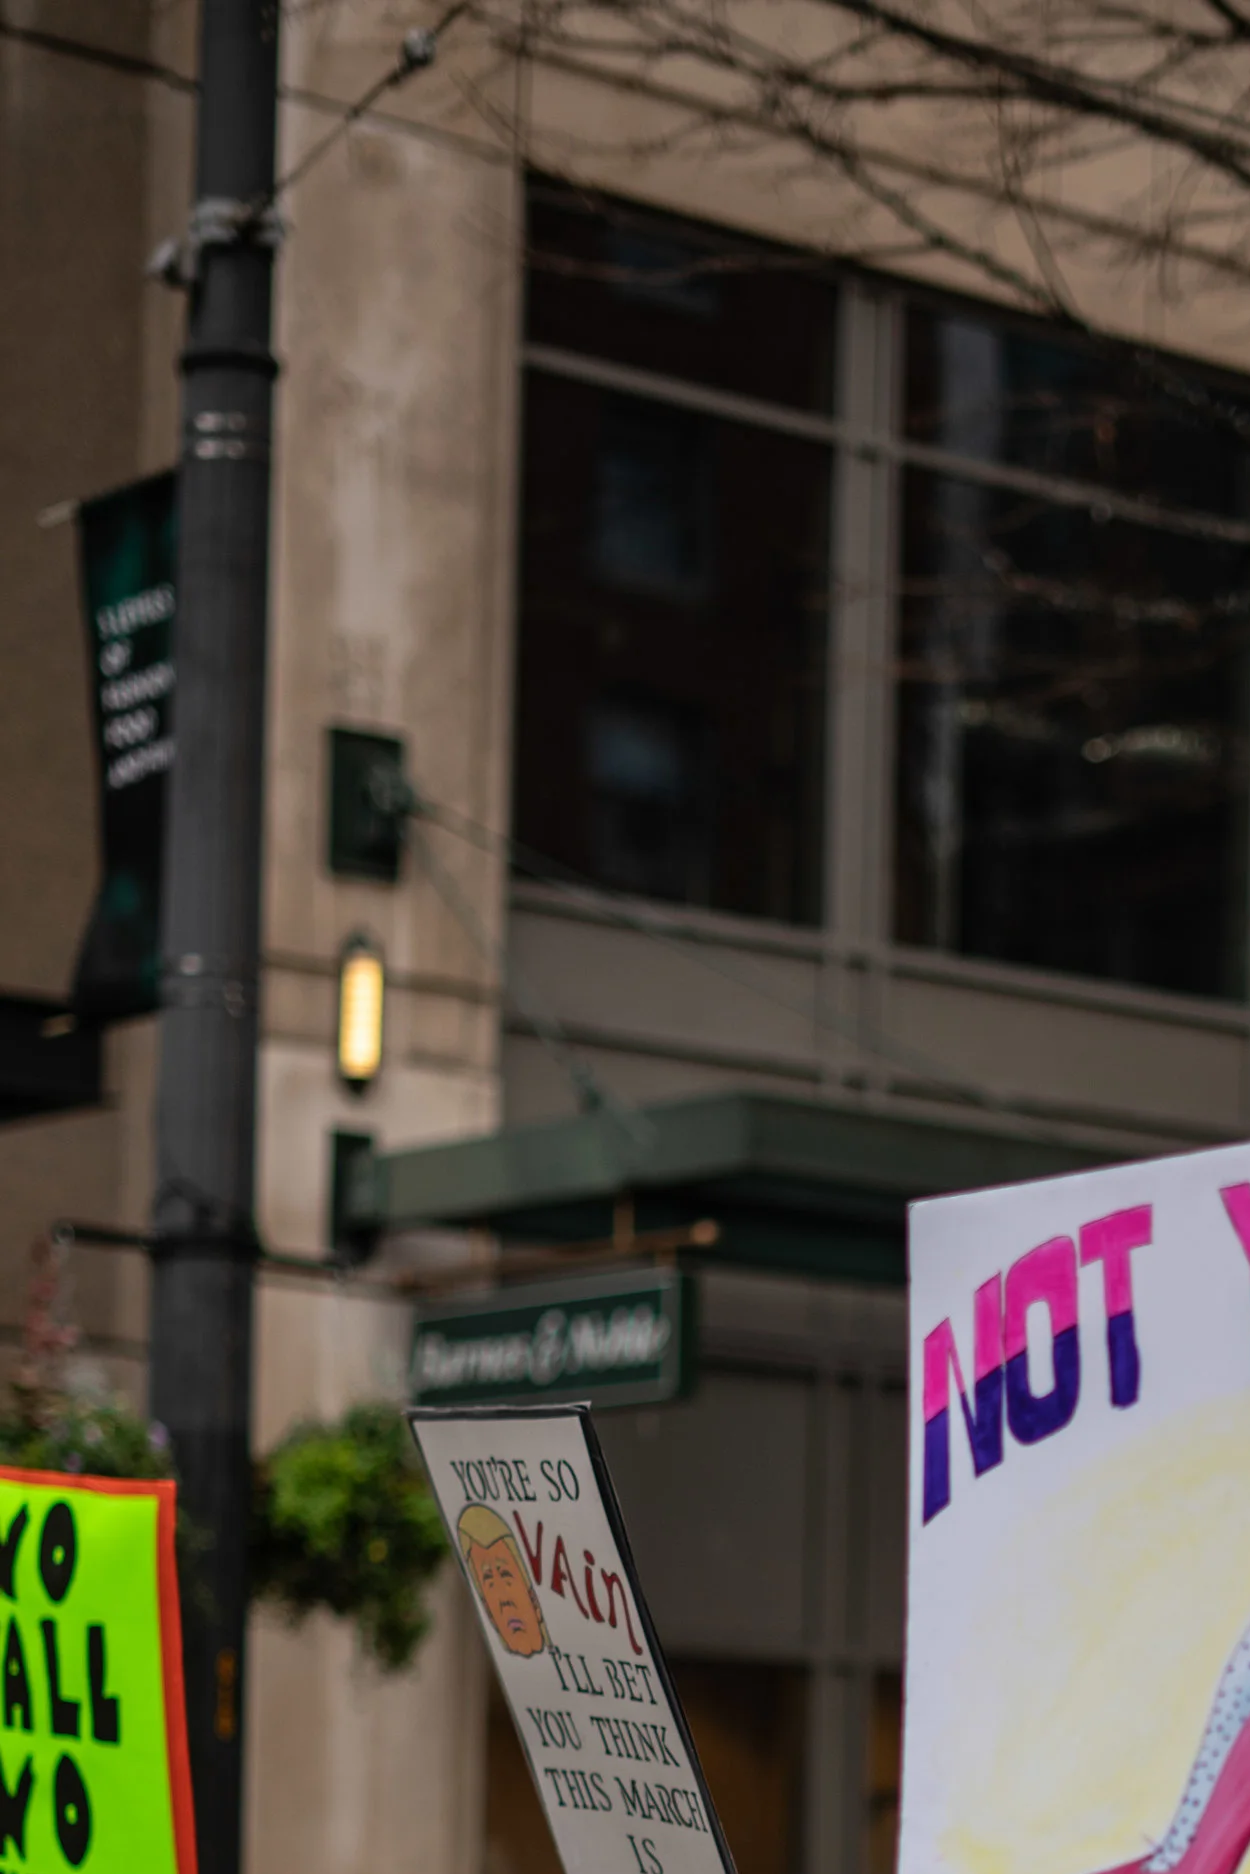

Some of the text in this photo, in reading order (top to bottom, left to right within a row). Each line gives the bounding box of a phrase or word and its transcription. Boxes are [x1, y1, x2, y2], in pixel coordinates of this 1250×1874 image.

[922, 1203, 1153, 1528] NOT
[450, 1455, 580, 1502] YOU'RE SO
[0, 1613, 121, 1747] ALL
[549, 1646, 658, 1705] I'LL BET
[526, 1707, 680, 1768] YOU THINK
[544, 1767, 709, 1833] THIS MARCH
